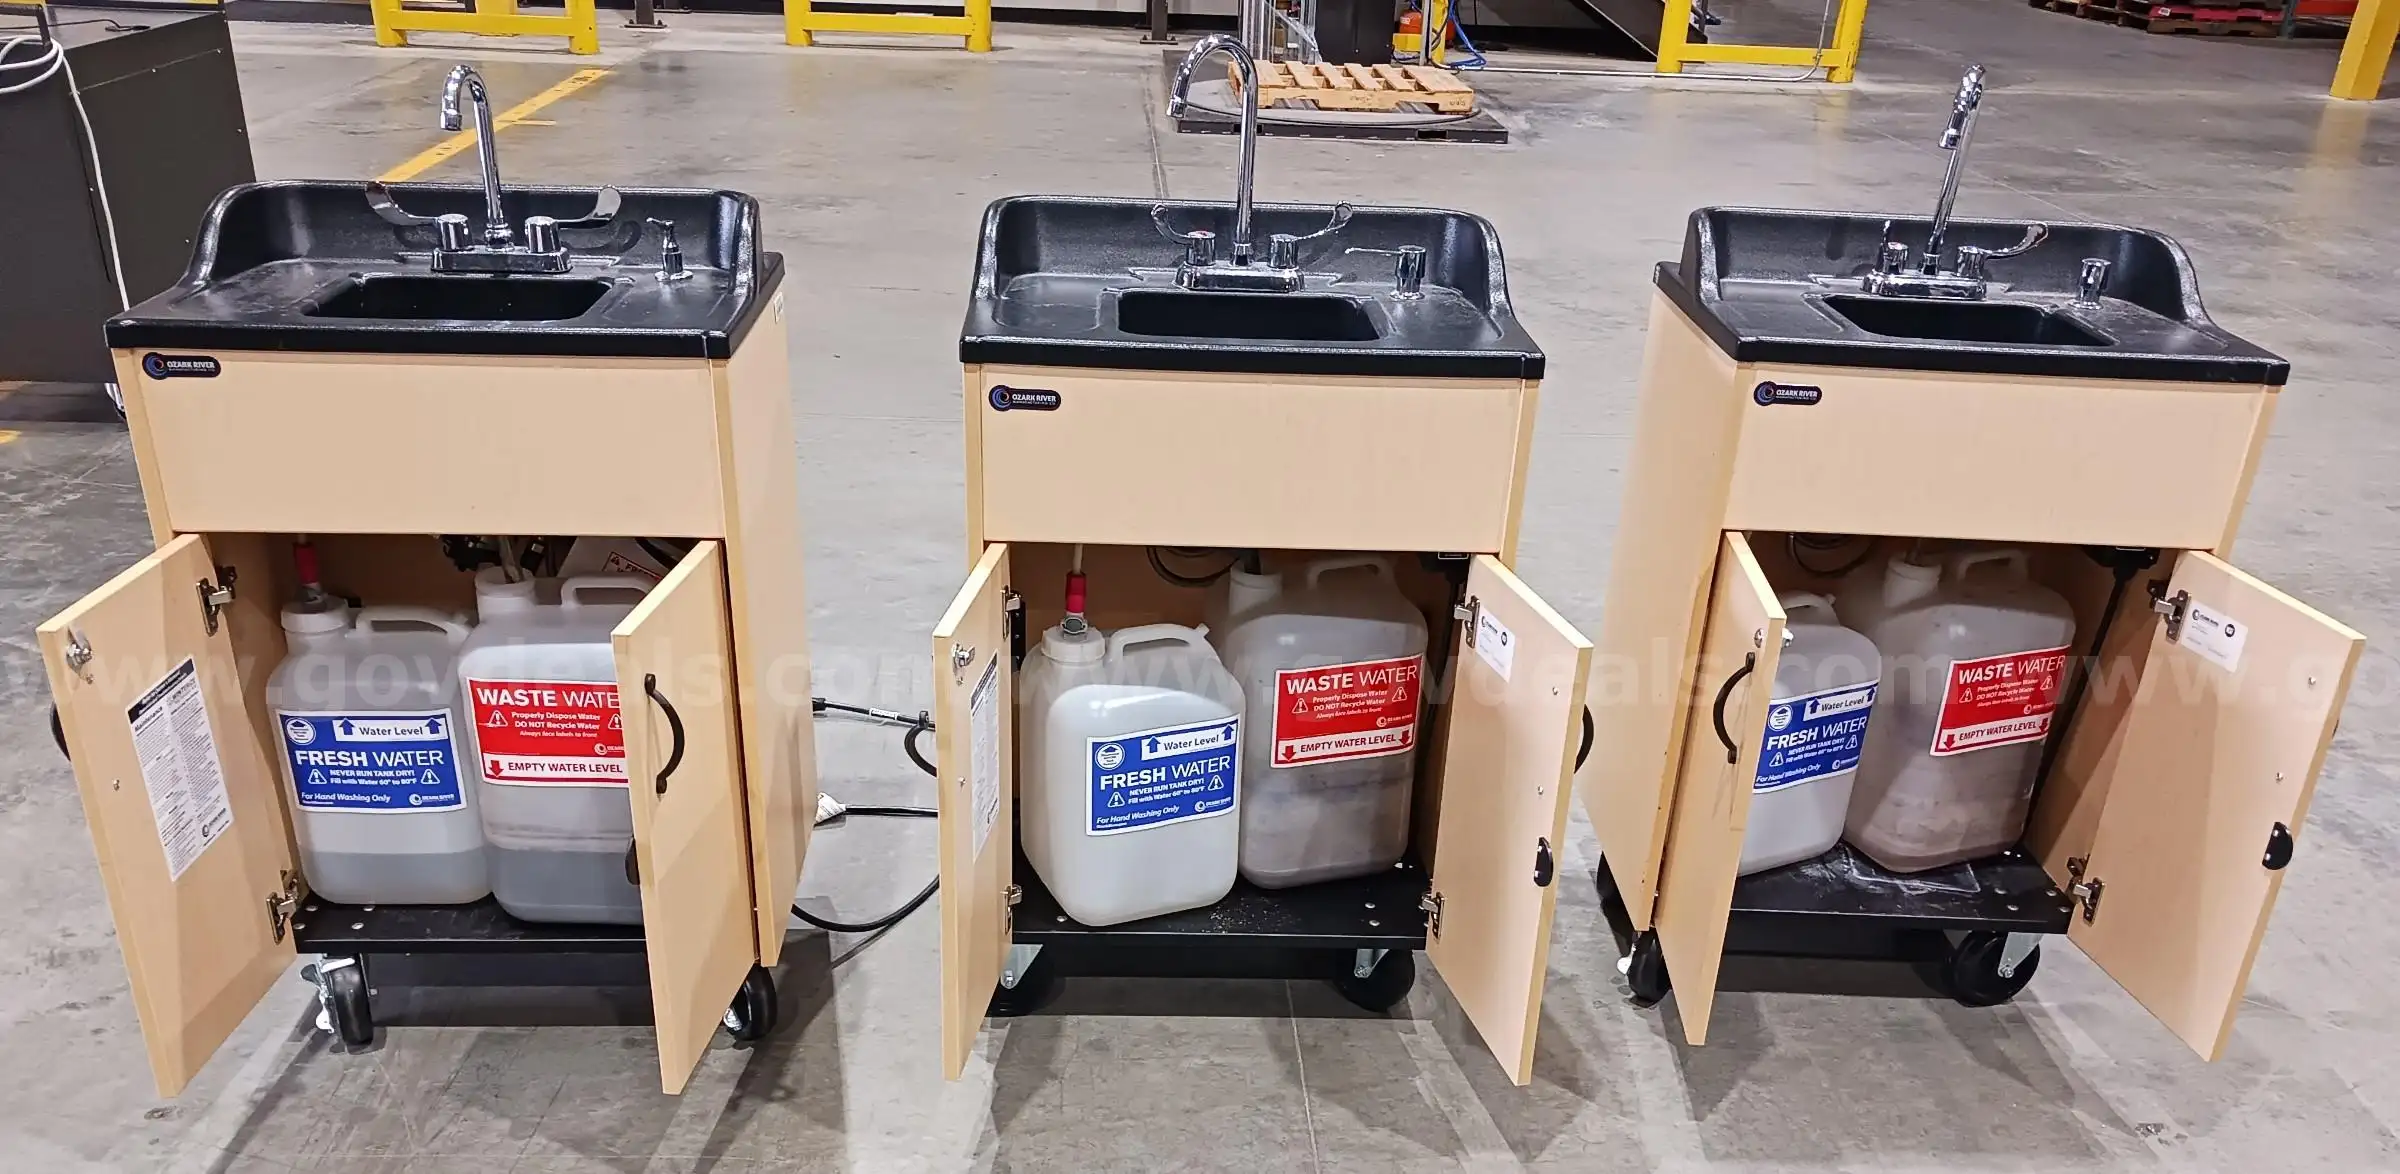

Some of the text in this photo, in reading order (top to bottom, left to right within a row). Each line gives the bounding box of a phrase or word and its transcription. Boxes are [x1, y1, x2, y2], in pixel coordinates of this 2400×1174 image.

[1959, 655, 2066, 684] WASTE WATER
[1286, 665, 1417, 694] WASTE WATER
[476, 688, 620, 708] WASTE WATE
[1312, 695, 1340, 704] Properly
[1341, 692, 1368, 700] Dispose
[1821, 696, 1864, 711] Water Level
[511, 712, 544, 720] Properly
[546, 712, 578, 720] Dispose
[358, 726, 424, 736] Water Level
[1766, 716, 1867, 751] FRESH WATER
[1959, 721, 2036, 740] EMPTY WATER LEVEL
[1164, 735, 1219, 750] Water Level
[1300, 734, 1396, 753] EMPTY WATER LEVEL
[295, 750, 444, 766] FRESH WATER
[508, 762, 623, 773] EMPTY WATER LEVEL
[1100, 756, 1231, 790] FRESH WATER
[1785, 768, 1807, 777] Washing
[1129, 778, 1204, 796] NEVER RUN TANK DRY!
[337, 793, 370, 803] Washing
[371, 794, 391, 803] Only
[1154, 792, 1171, 800] Water
[1110, 813, 1131, 823] Hand
[1132, 809, 1162, 819] Washing
[1163, 805, 1180, 814] Only
